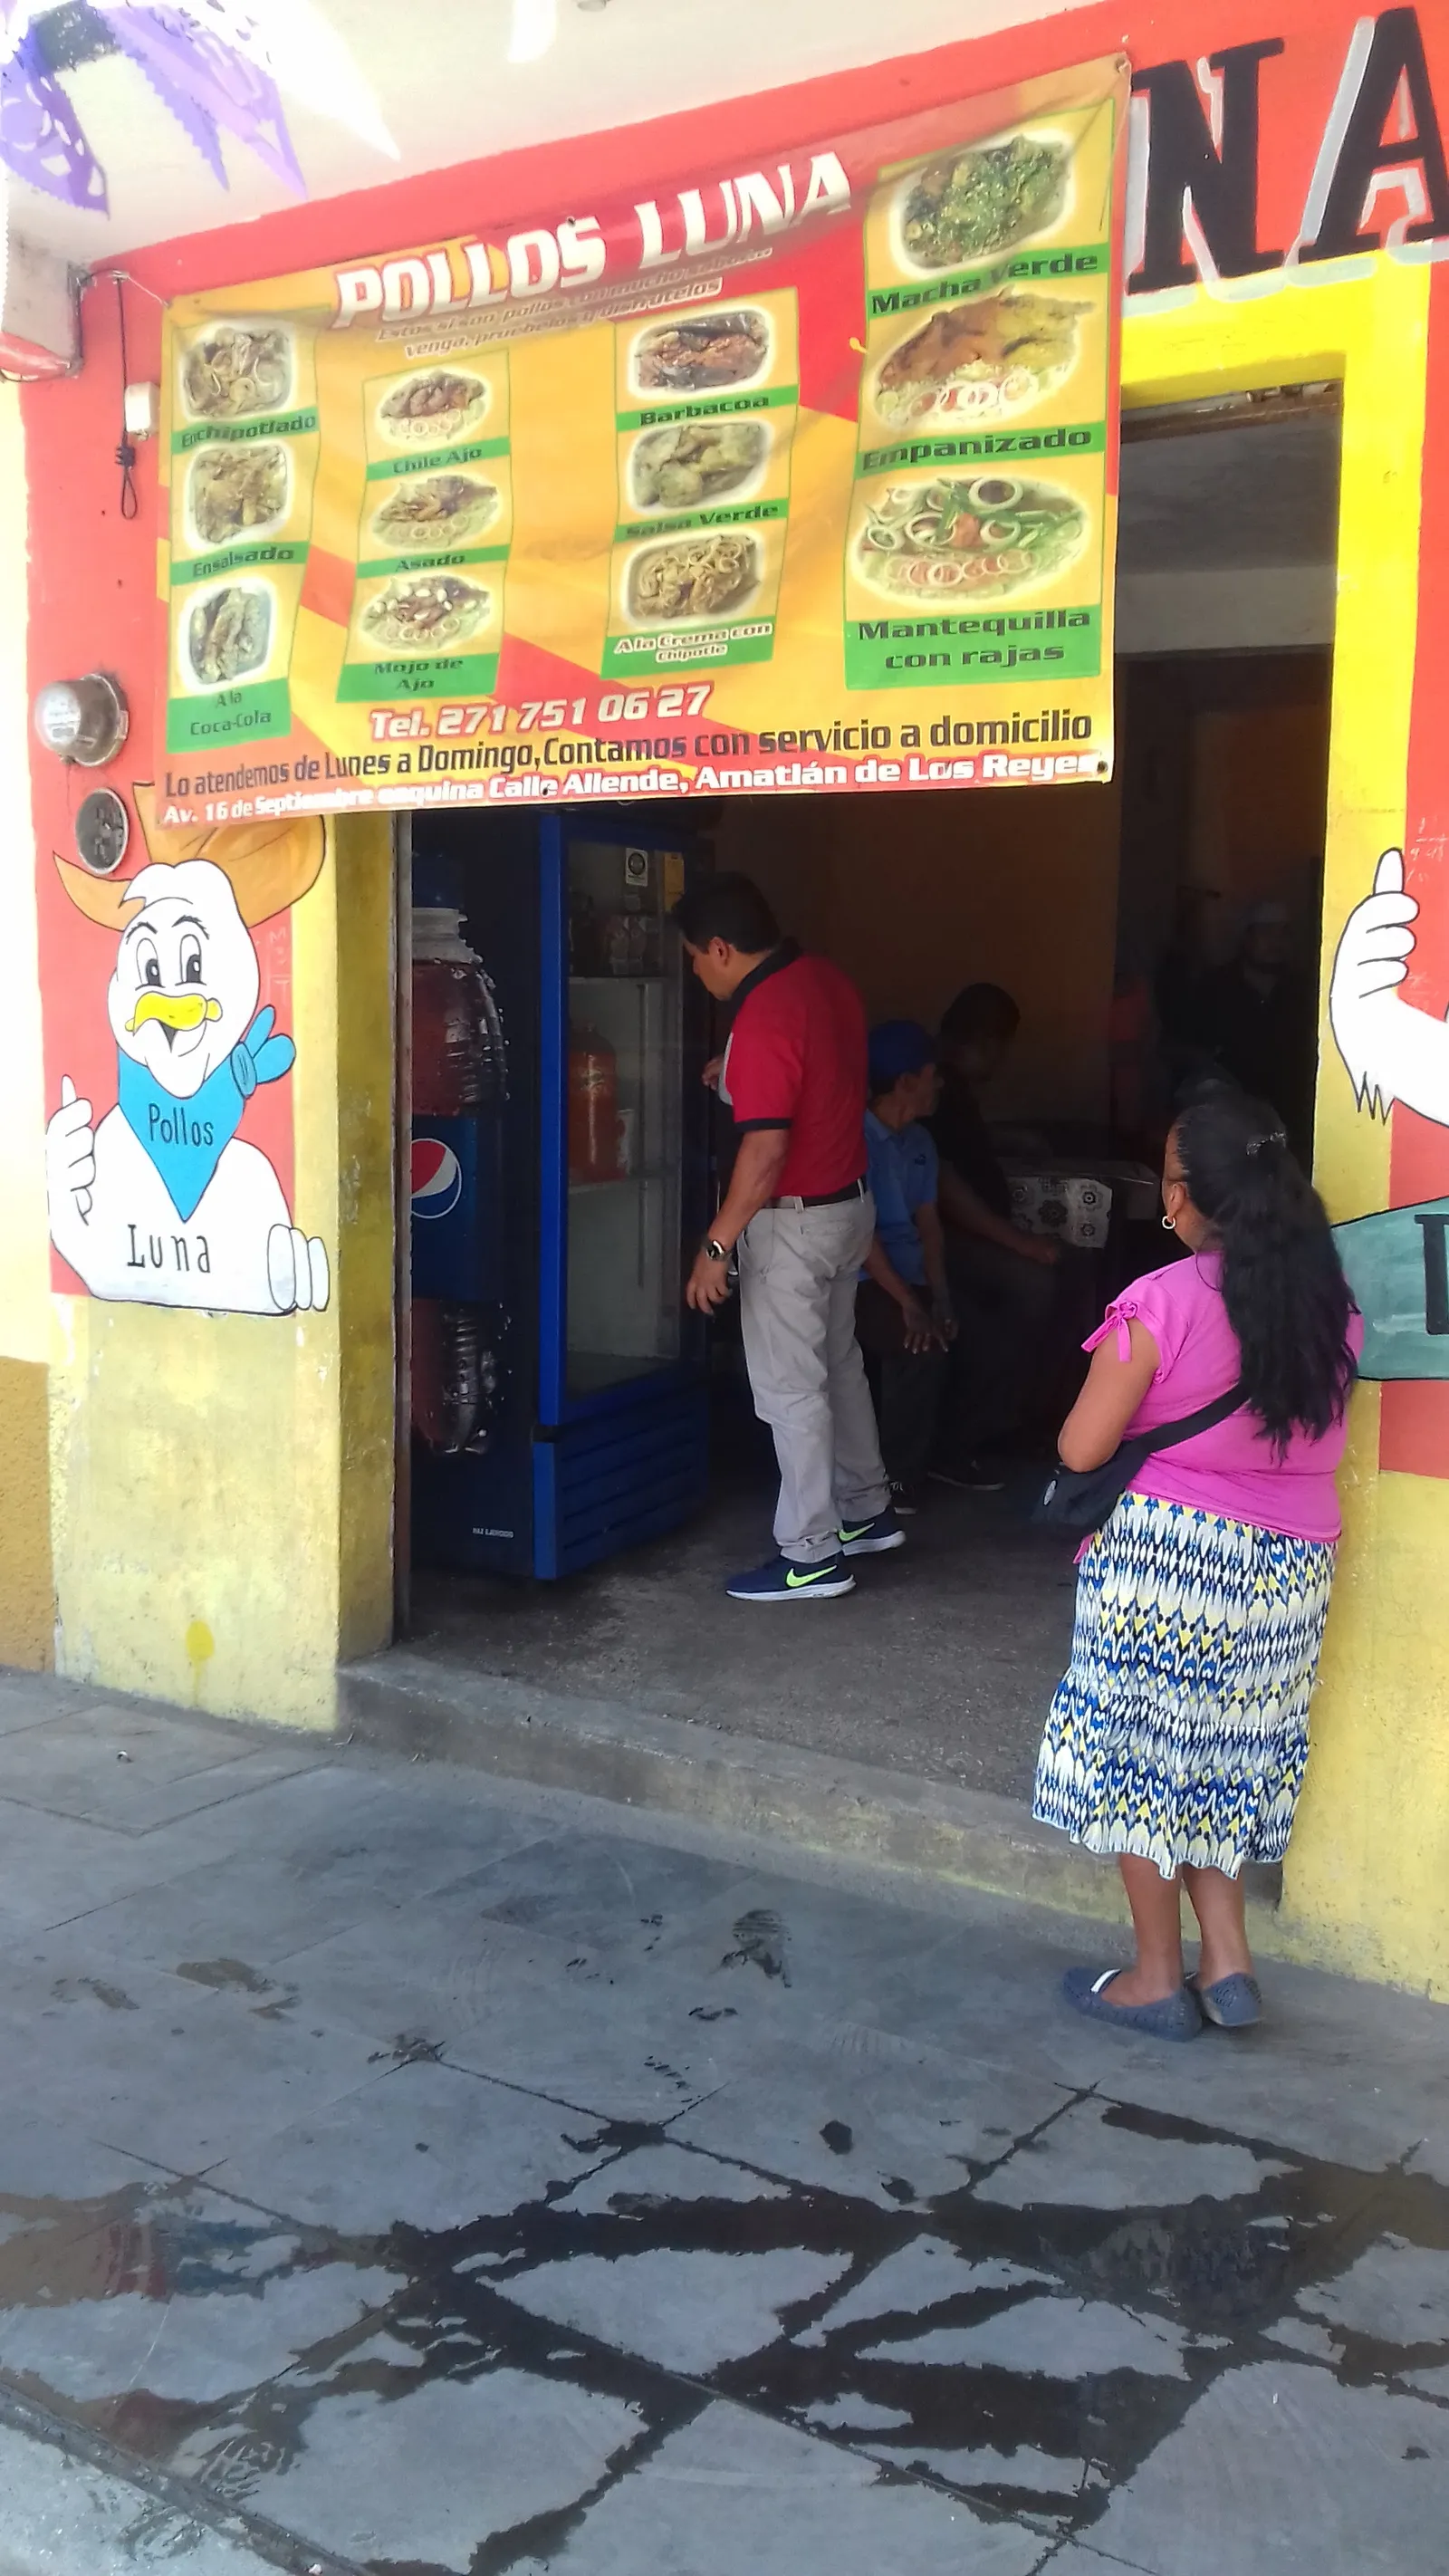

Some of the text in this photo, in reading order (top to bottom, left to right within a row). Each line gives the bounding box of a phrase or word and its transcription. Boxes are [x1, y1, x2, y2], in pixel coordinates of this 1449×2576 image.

[331, 151, 852, 329] POLLOS LUNA
[870, 253, 1099, 315] Macha Verde
[639, 396, 770, 426] Barbacoa
[392, 447, 483, 475] Chile Ajo
[862, 428, 1092, 471] Empanizado
[626, 505, 779, 538] Salsa Verde
[192, 545, 294, 578] Ensalsado
[394, 553, 465, 572] Asado
[657, 629, 728, 649] Crema
[730, 622, 772, 639] con
[858, 609, 1091, 641] Mantequilla
[374, 657, 465, 676] Mojo de
[657, 643, 728, 663] Chipotle
[884, 643, 1066, 670] con rajas
[215, 689, 243, 710] A la
[396, 677, 435, 692] Ajo
[189, 709, 272, 737] Coca-Cola
[370, 684, 713, 741] Tel. 271 751 06 27
[165, 771, 190, 799] Lo
[195, 763, 288, 795] atendemos
[294, 755, 320, 782] de
[325, 751, 391, 778] Lunes
[398, 752, 411, 774] a
[694, 732, 750, 757] con
[758, 719, 891, 754] servicio
[899, 724, 921, 748] a
[929, 708, 1092, 747] domicilio
[164, 804, 197, 825] Av.
[205, 802, 228, 822] 16
[231, 798, 254, 818] de
[254, 786, 374, 817] Septiembre
[377, 782, 485, 808] esquina
[489, 774, 558, 798] Calle
[562, 768, 689, 794] Allende,
[695, 762, 848, 791] Amatlán
[854, 758, 902, 783] de
[907, 756, 975, 781] Los
[148, 1102, 215, 1148] Pollos
[126, 1223, 211, 1274] Luna
